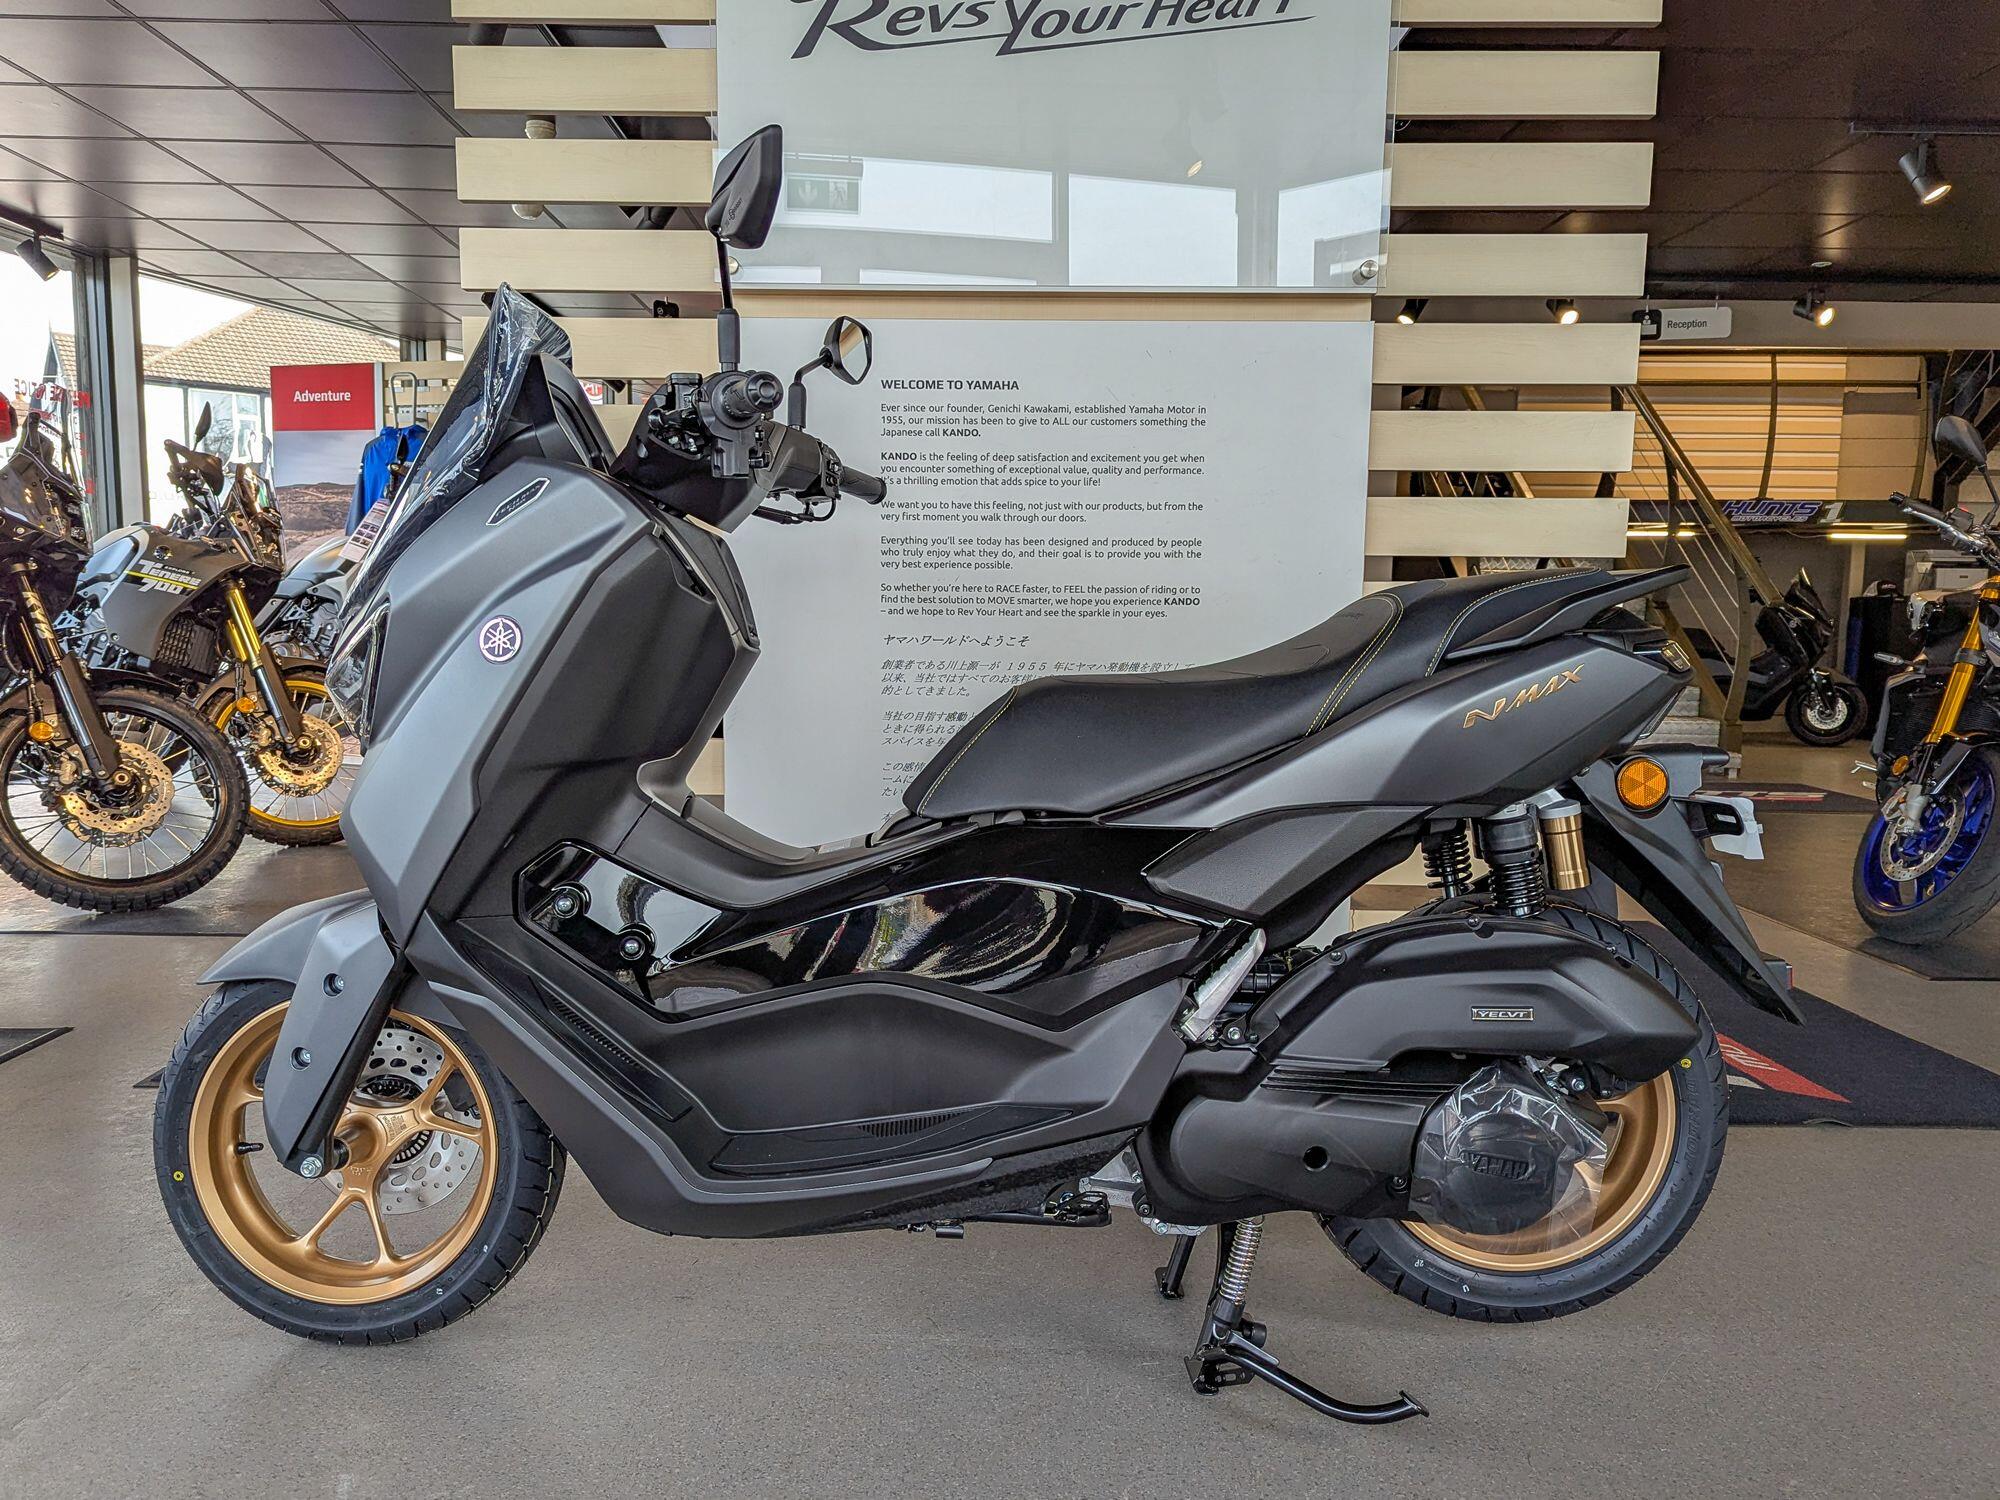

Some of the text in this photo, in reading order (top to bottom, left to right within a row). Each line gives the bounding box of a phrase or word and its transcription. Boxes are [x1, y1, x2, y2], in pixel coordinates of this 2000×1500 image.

[790, 0, 996, 59] Revs
[996, 0, 1143, 56] Your
[1667, 319, 1708, 330] Reception
[880, 380, 1019, 389] WELCOME TO YAMAHA
[294, 390, 351, 402] Adventure
[880, 403, 900, 412] Ever
[903, 404, 925, 412] since
[946, 404, 984, 413] founder,
[988, 404, 1020, 412] Genichi
[1024, 404, 1071, 414] Kawakami,
[1074, 404, 1126, 413] established
[1128, 405, 1164, 413] Yamaha
[1167, 405, 1195, 413] Motor
[1198, 405, 1206, 413] in
[881, 416, 905, 425] 1955,
[926, 416, 960, 424] mission
[962, 416, 978, 424] has
[980, 416, 1003, 424] been
[1018, 416, 1037, 427] give
[1052, 416, 1069, 425] ALL
[1140, 417, 1187, 427] something
[1190, 417, 1206, 425] the
[880, 428, 922, 438] Japanese
[880, 452, 1204, 464] KANDO is the feeling of deep satisfaction and excitement you get when
[880, 466, 896, 475] you
[947, 464, 994, 475] something
[996, 464, 1006, 473] of
[1008, 464, 1060, 475] exceptional
[1062, 465, 1090, 474] value,
[1092, 465, 1122, 476] quality
[1124, 465, 1141, 474] and
[1144, 465, 1204, 476] performance.
[881, 500, 894, 508] We
[921, 503, 937, 511] you
[951, 500, 971, 509] have
[974, 501, 990, 509] this
[992, 501, 1025, 511] feeling,
[1044, 502, 1061, 511] just
[1063, 501, 1083, 509] with
[1102, 501, 1144, 512] products,
[1146, 502, 1162, 510] but
[1164, 502, 1185, 510] from
[1188, 502, 1203, 510] the
[1722, 500, 1822, 516] HUNTS
[880, 536, 928, 547] Everything
[976, 536, 1001, 547] today
[1004, 537, 1019, 545] has
[1022, 537, 1044, 545] been
[1048, 537, 1088, 548] designed
[1091, 537, 1108, 546] and
[1111, 537, 1154, 548] produced
[1157, 537, 1168, 548] by
[1170, 538, 1201, 548] people
[880, 560, 1012, 570] very best experience possible.
[138, 578, 184, 594] 700
[880, 583, 891, 592] So
[893, 583, 931, 592] whether
[962, 584, 982, 592] here
[996, 584, 1020, 592] RACE
[1022, 584, 1050, 594] faster,
[1064, 584, 1085, 593] FEEL
[1087, 584, 1102, 593] the
[1104, 584, 1137, 595] passion
[1139, 585, 1149, 593] of
[1151, 585, 1176, 595] riding
[880, 594, 898, 603] find
[900, 595, 914, 604] the
[917, 595, 936, 604] best
[938, 595, 973, 604] solution
[987, 595, 1014, 604] MOVE
[1016, 596, 1053, 605] smarter,
[1070, 595, 1092, 606] hope
[1094, 598, 1110, 607] you
[1112, 596, 1161, 607] experience
[1164, 596, 1200, 605] KANDO
[921, 607, 943, 617] hope
[1078, 608, 1110, 618] sparkle
[884, 635, 1030, 647] ヤマハワールドへようこそ
[881, 685, 970, 697] 的としてきました。
[1463, 663, 1585, 729] NMAX
[882, 724, 964, 734] ときに得られる
[1471, 1154, 1529, 1180] YAMAH
